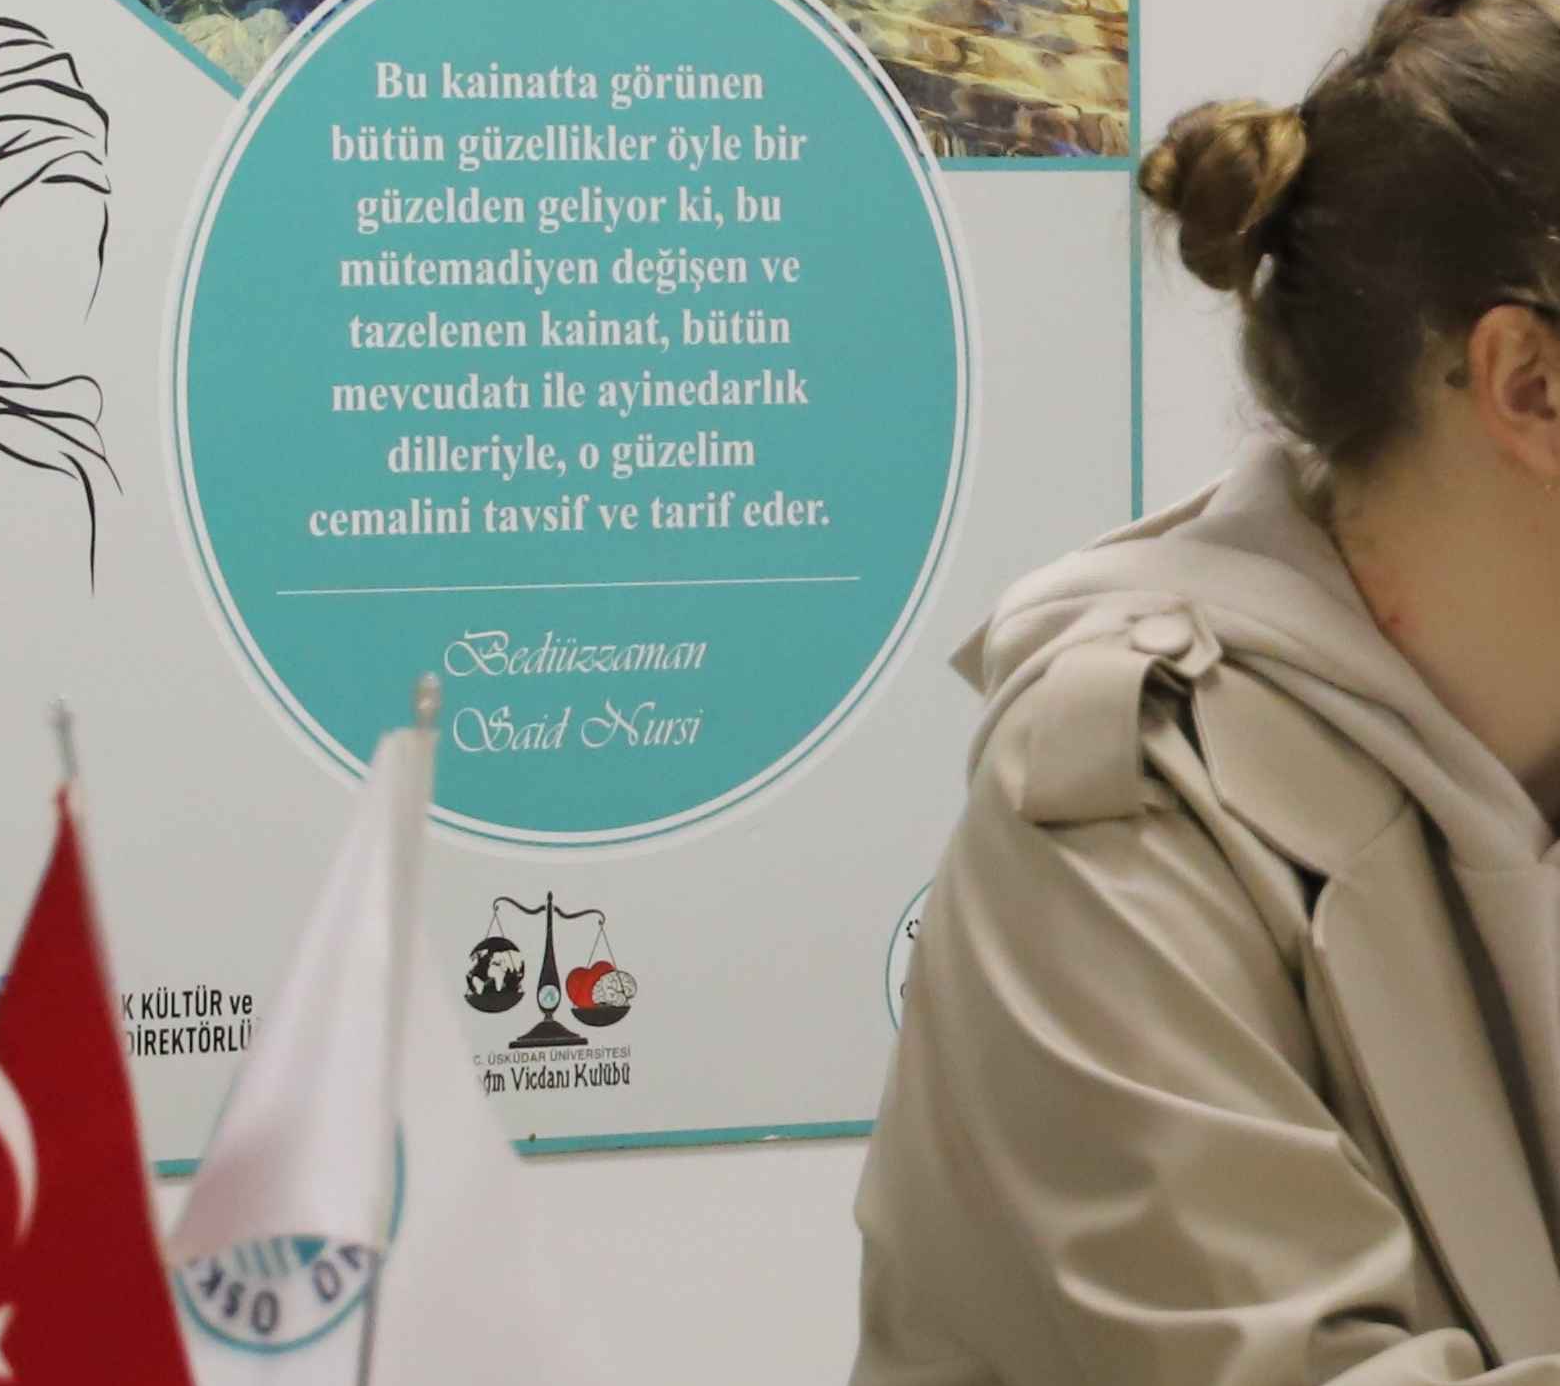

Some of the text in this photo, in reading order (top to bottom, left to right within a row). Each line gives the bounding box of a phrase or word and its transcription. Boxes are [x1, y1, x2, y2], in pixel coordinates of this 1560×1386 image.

[375, 60, 765, 110] Bu kainatta görünen
[330, 123, 809, 173] bütün güzellikler öyle bir
[355, 184, 782, 236] güzelden geliyor ki, bu
[339, 246, 801, 296] mütemadiyen değişen ve
[347, 308, 792, 352] tazelenen kainat, bütün
[331, 368, 809, 419] mevcudatı ile ayinedarlık
[387, 429, 756, 482] dilleriyle, o güzelim
[307, 489, 831, 538] cemalini tavsif ve tarif eder.
[443, 629, 708, 678] Bediüzzaman
[452, 699, 704, 753] Said Nursi
[141, 985, 222, 1019] KÜLTÜR
[230, 994, 252, 1015] ve
[126, 1018, 253, 1057] İREKTÖRLÜ
[488, 1050, 546, 1065] ÜSKÜDAR
[550, 1045, 631, 1062] ÜNİVERSİTESİ
[483, 1061, 631, 1096] ğın Vicdanı Kulübü
